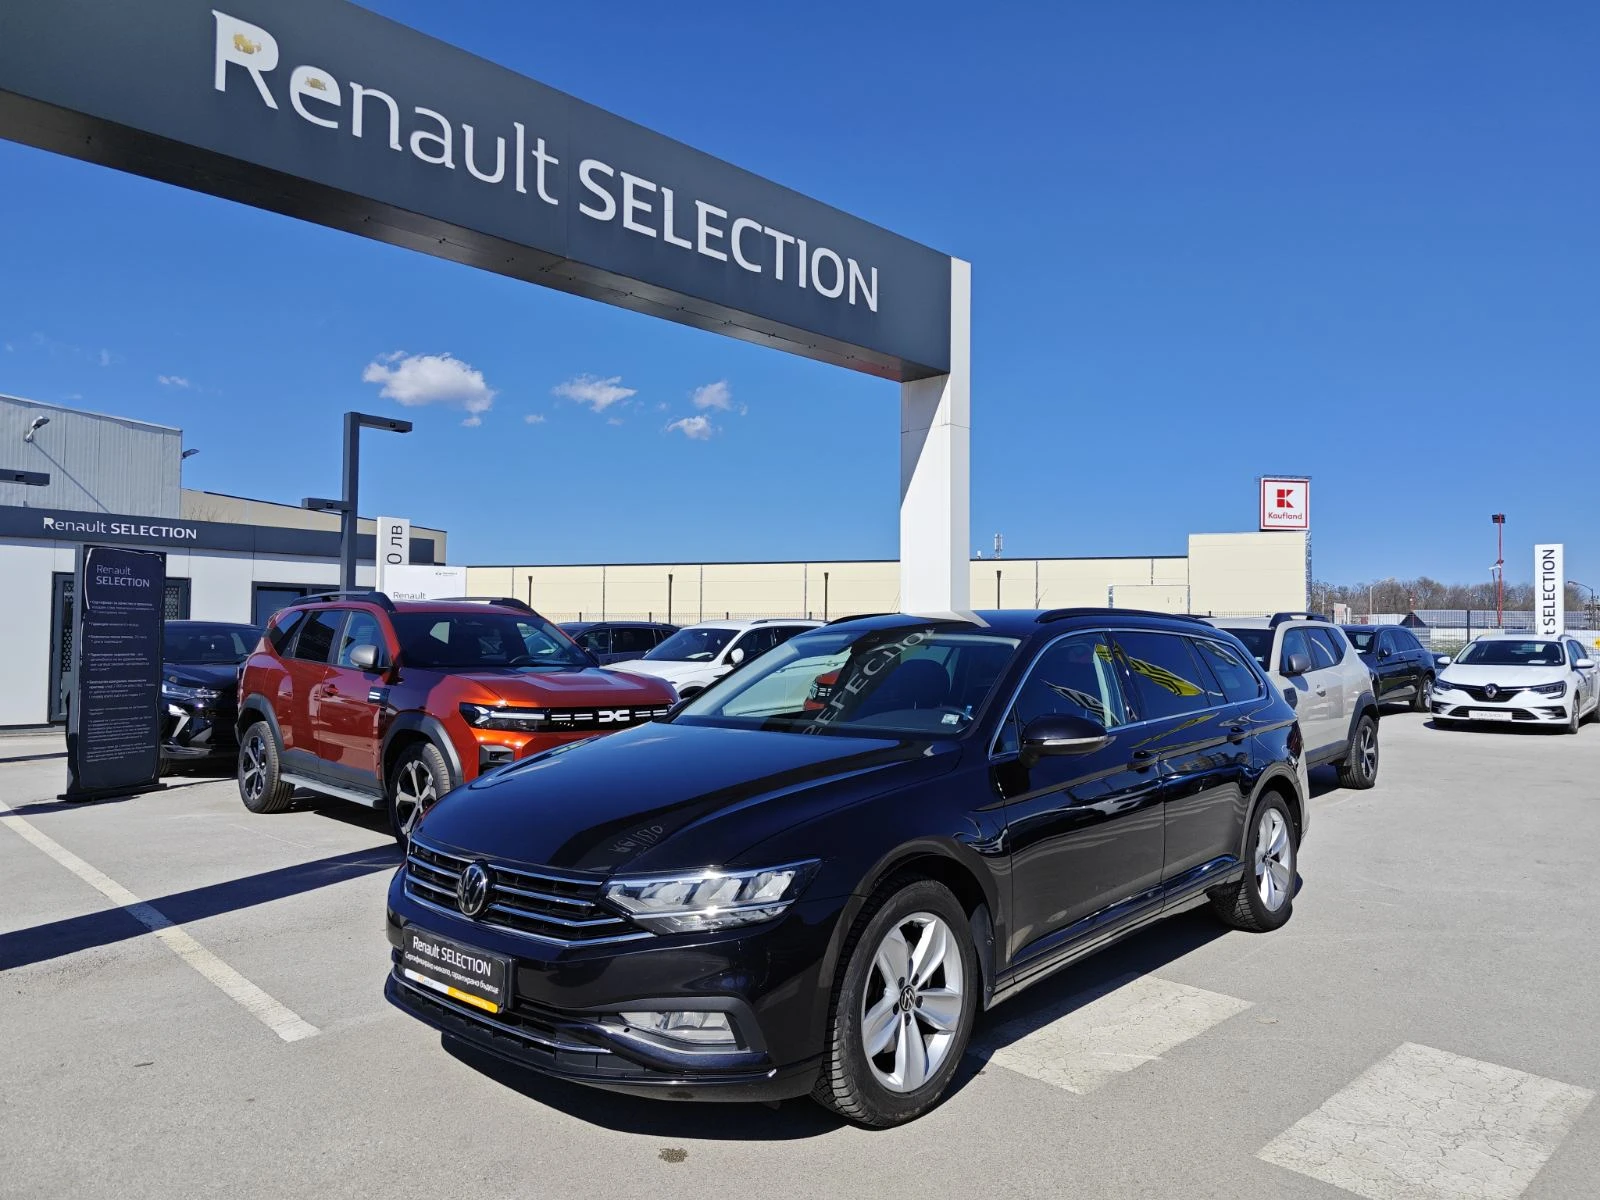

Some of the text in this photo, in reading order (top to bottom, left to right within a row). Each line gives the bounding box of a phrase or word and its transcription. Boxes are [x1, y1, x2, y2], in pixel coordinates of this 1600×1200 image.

[211, 9, 878, 313] Renault SELECTION
[1268, 511, 1303, 520] Kaufland
[43, 517, 197, 540] Renault SELECTION
[96, 564, 132, 577] Renault
[96, 575, 150, 588] SELECTION
[1542, 549, 1556, 627] SELECTION
[393, 591, 427, 600] Renault
[412, 935, 492, 977] Renault SELECTION
